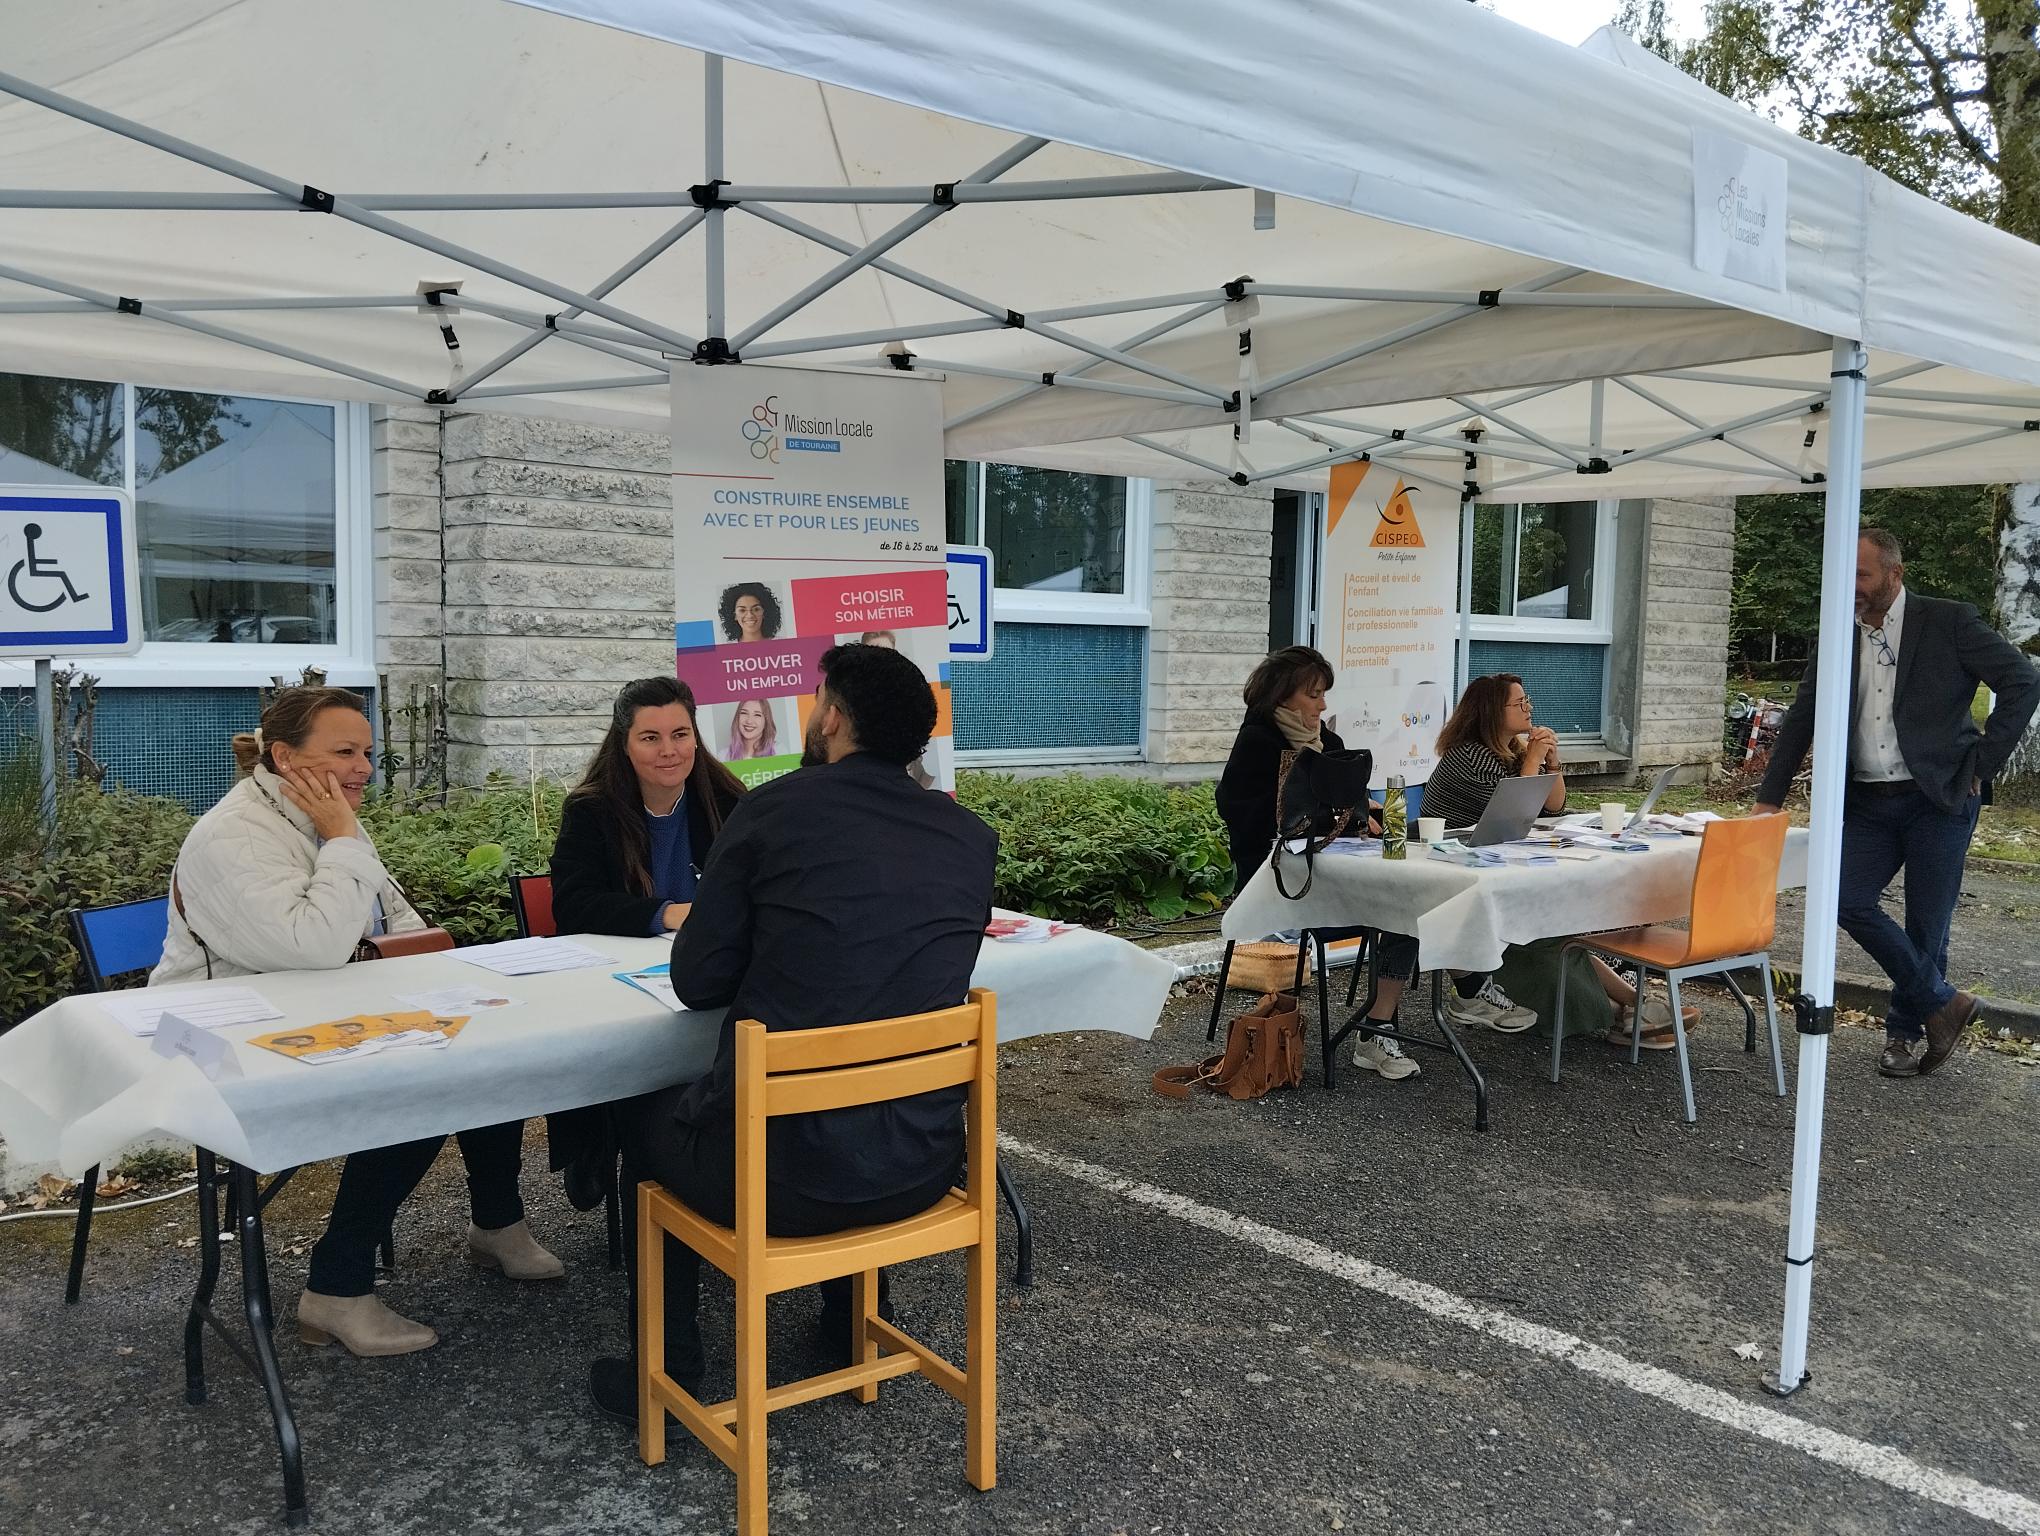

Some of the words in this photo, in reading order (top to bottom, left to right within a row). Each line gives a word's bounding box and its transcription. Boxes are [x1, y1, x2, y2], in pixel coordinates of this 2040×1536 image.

[1736, 183, 1749, 200] Les
[1736, 200, 1766, 229] Missions
[1734, 223, 1760, 247] Locales
[785, 414, 832, 435] Mission
[836, 418, 873, 437] Locale
[802, 442, 838, 450] TOURAINE
[714, 490, 822, 508] CONSTRUIRE
[827, 494, 909, 511] ENSEMBLE
[703, 513, 749, 528] AVEC
[754, 514, 774, 528] ET
[779, 515, 826, 530] POUR
[831, 517, 859, 531] LES
[863, 518, 919, 533] JEUNES
[880, 541, 891, 551] de
[892, 541, 903, 551] 16
[905, 541, 911, 551] à
[913, 542, 923, 552] 25
[1376, 533, 1419, 545] CISPEO
[1349, 573, 1379, 583] Accueil
[1382, 573, 1390, 583] et
[1411, 572, 1421, 583] de
[840, 588, 905, 606] CHOISIR
[1348, 586, 1379, 597] l'enfant
[835, 610, 864, 623] SON
[867, 606, 914, 621] MÉTIER
[1347, 607, 1397, 618] Conciliation
[1399, 607, 1410, 617] vie
[1411, 606, 1444, 616] familiale
[1347, 621, 1355, 631] et
[1356, 620, 1418, 632] professionnelle
[1346, 643, 1418, 655] Accompagnement
[1427, 642, 1435, 651] la
[722, 653, 803, 673] TROUVER
[1345, 656, 1389, 669] parentalité
[726, 678, 748, 692] UN
[751, 673, 803, 690] EMPLOI
